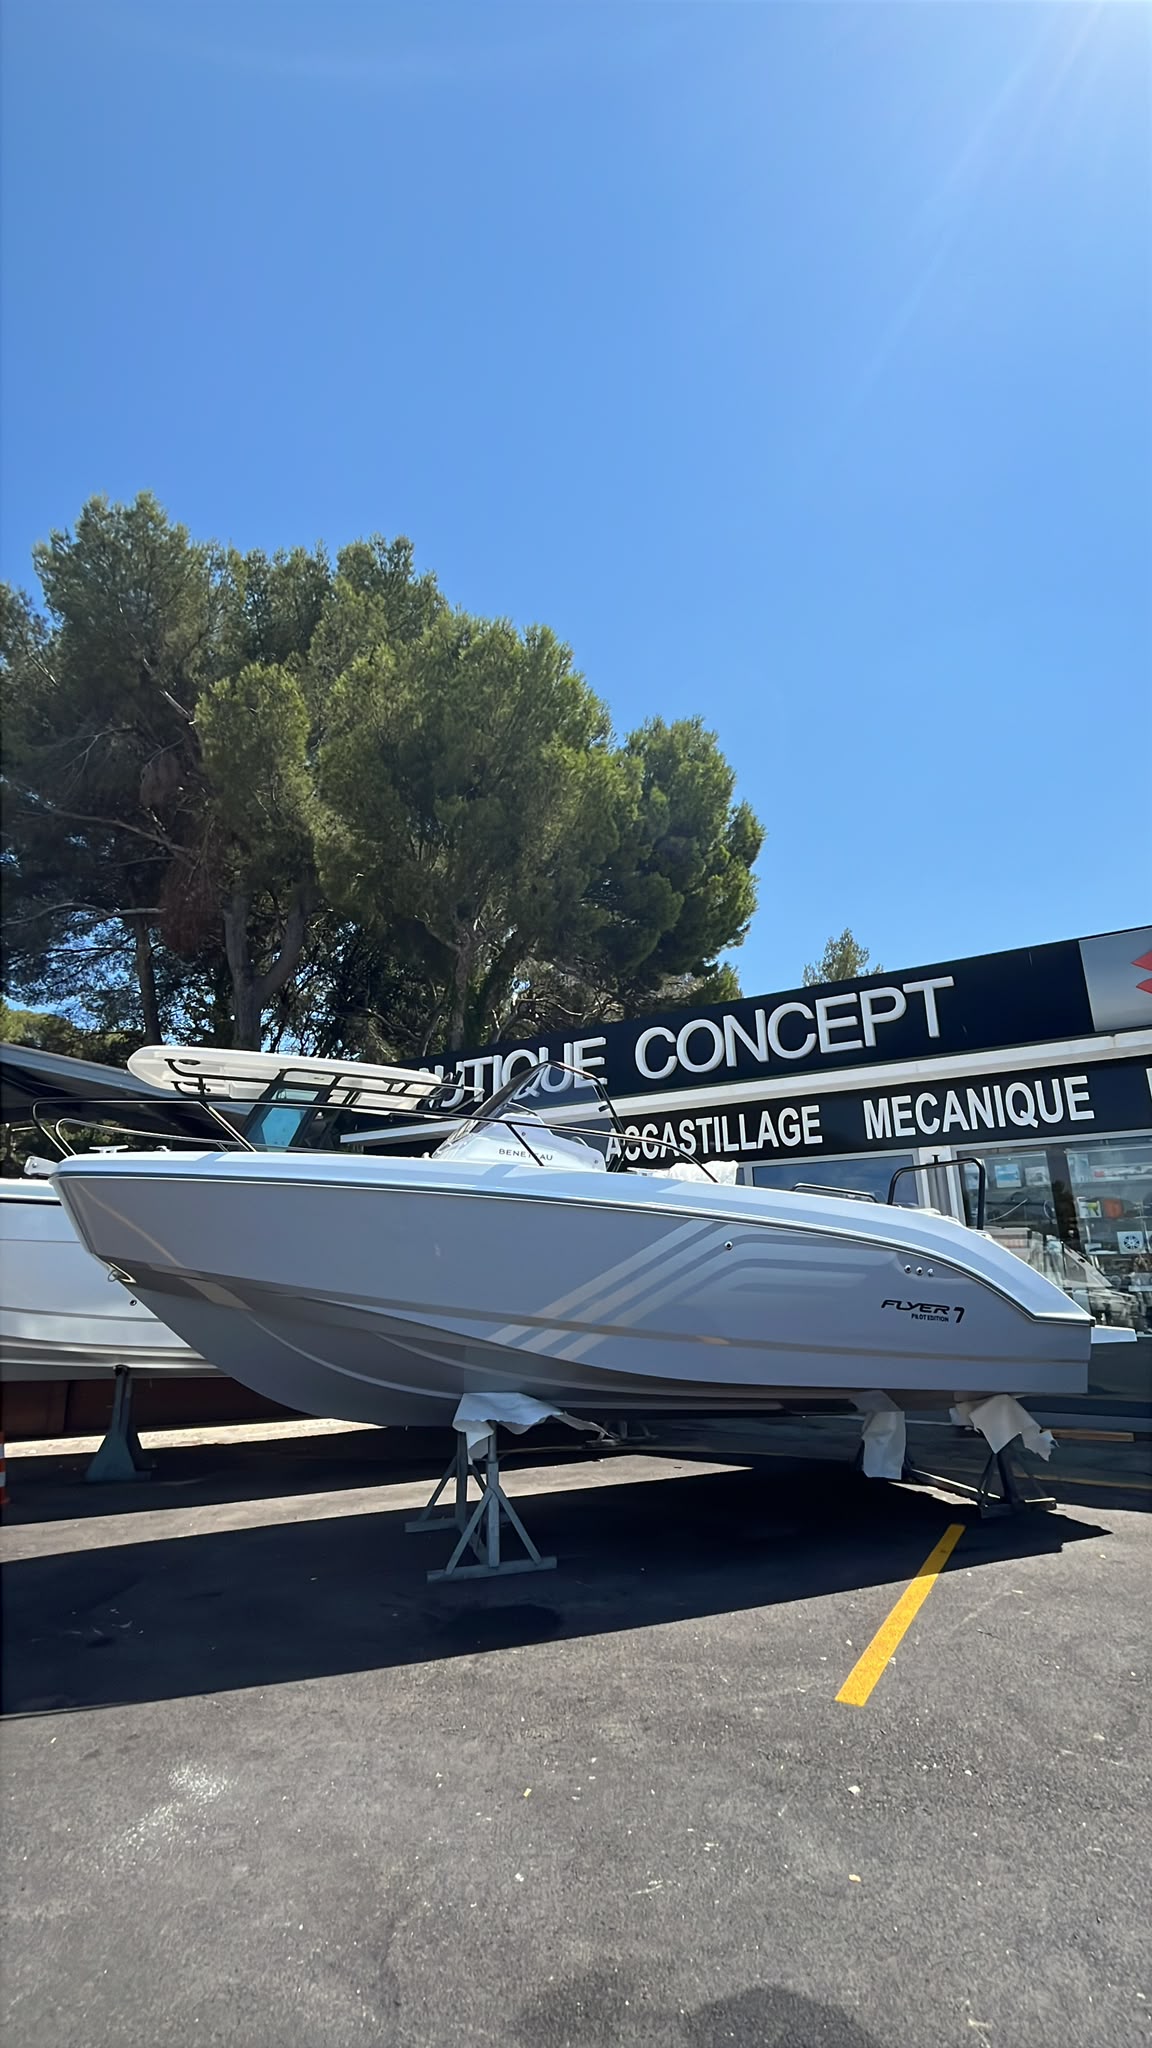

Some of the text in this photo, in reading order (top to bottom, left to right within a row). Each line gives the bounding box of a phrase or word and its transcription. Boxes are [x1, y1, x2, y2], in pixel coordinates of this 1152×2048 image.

[419, 976, 954, 1108] UTIQUE CONCEPT
[605, 1104, 823, 1162] ACCASTILLAGE
[863, 1075, 1095, 1140] MECANIQUE
[881, 1299, 965, 1324] FLYER 7
